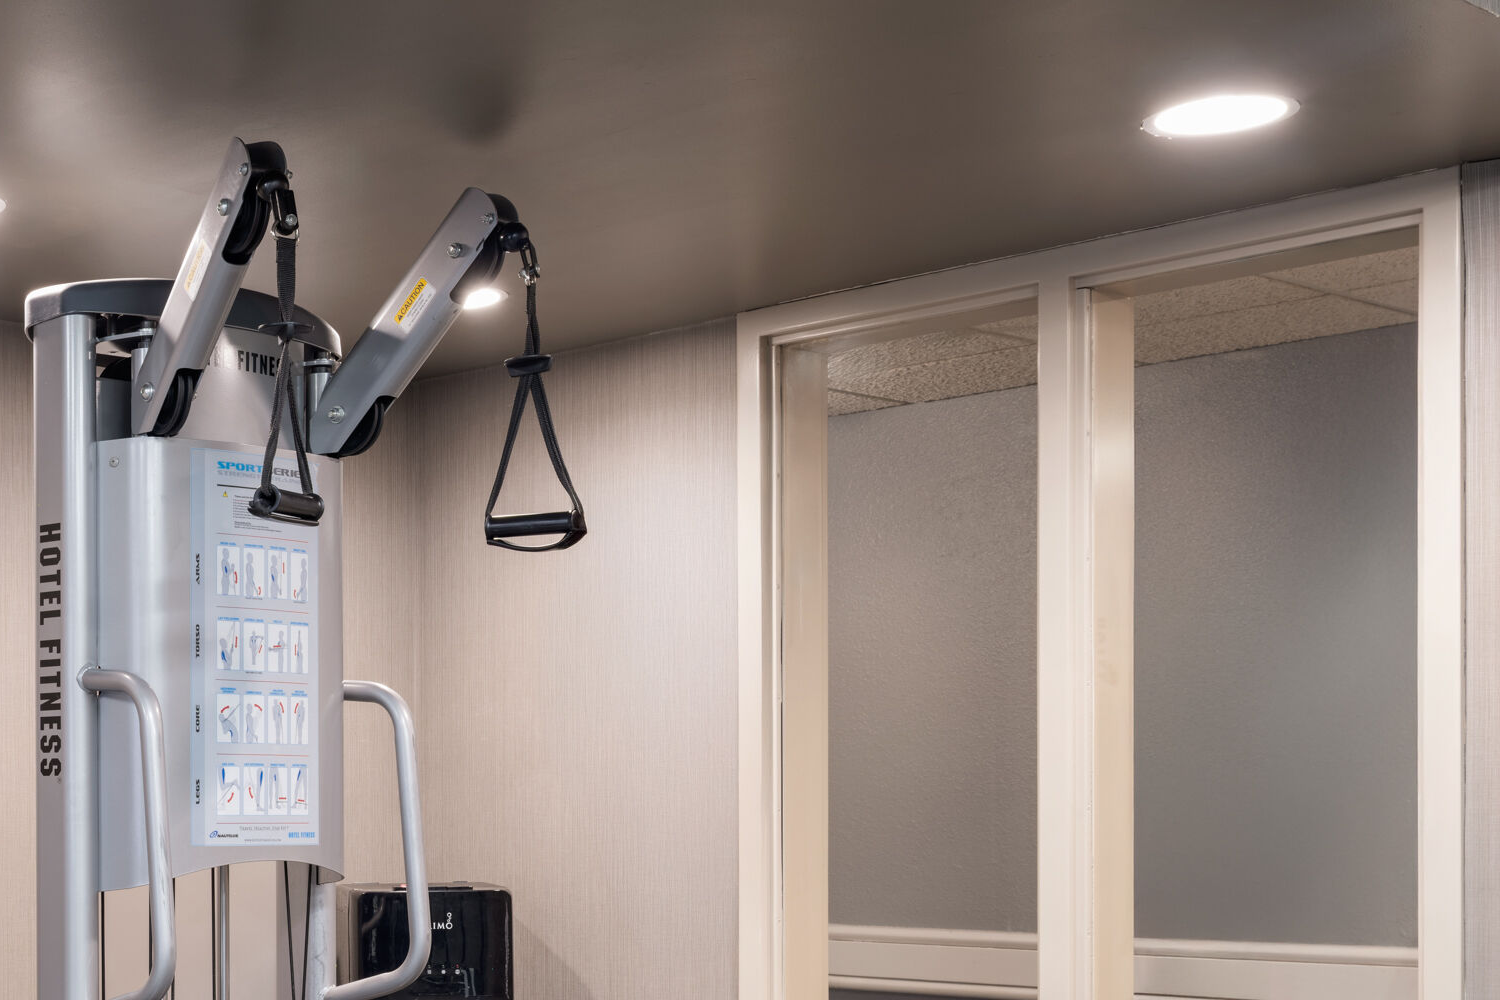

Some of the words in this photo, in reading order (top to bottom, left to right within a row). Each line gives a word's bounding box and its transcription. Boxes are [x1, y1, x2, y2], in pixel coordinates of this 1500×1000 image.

[400, 281, 425, 315] CAUTION
[238, 349, 281, 377] FITNE
[272, 467, 301, 479] ERIE
[40, 523, 61, 625] HOTEL
[40, 639, 62, 776] FITNESS
